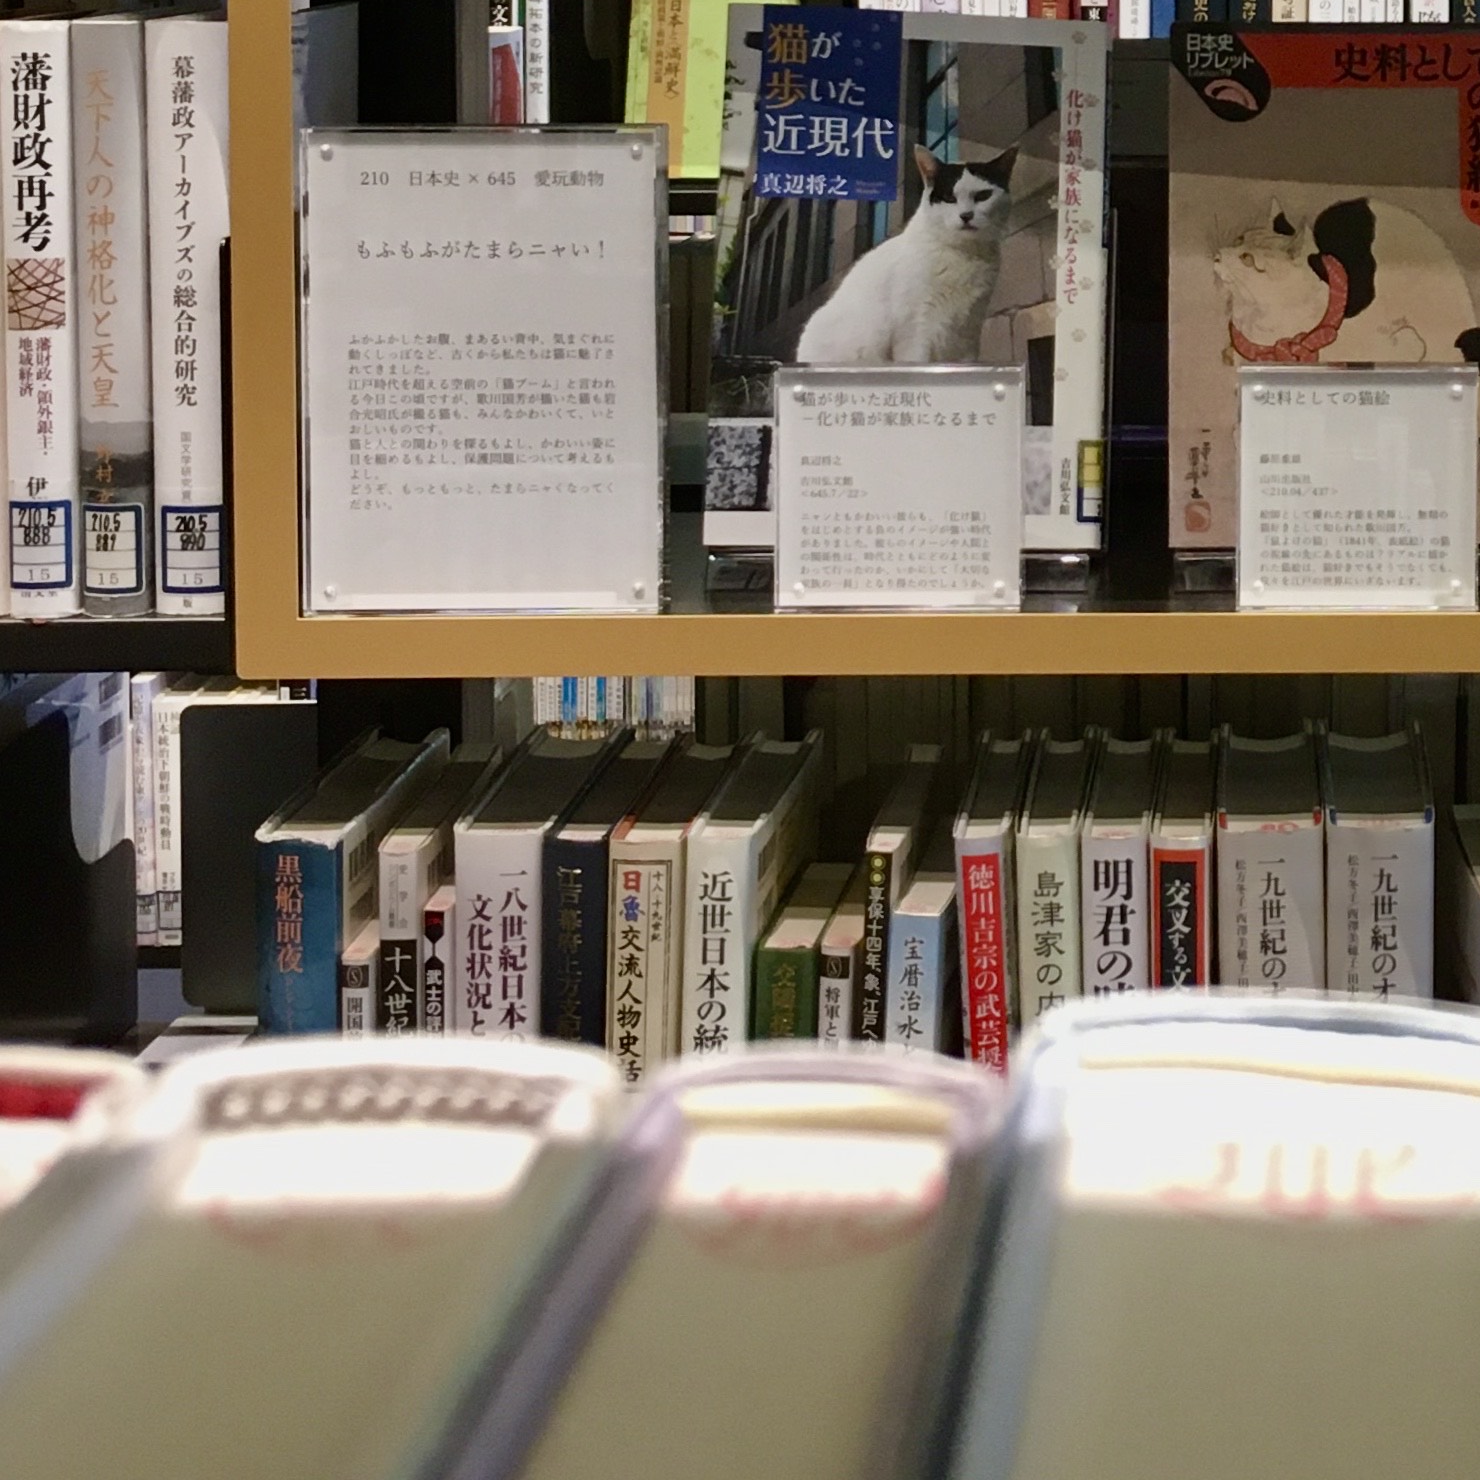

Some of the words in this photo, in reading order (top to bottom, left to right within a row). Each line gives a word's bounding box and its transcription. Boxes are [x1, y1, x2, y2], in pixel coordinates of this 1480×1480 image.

[768, 22, 843, 65] 猫が
[1186, 33, 1235, 52] 日本史
[1186, 53, 1255, 71] リブレット
[764, 68, 867, 110] 歩いた
[10, 52, 53, 253] 藩財政再考
[761, 113, 896, 161] 近現代
[360, 171, 390, 187] 210
[408, 170, 461, 188] 日本史
[487, 171, 516, 187] 645
[533, 169, 605, 188] 愛玩動物
[759, 173, 849, 197] 真辺将之
[1061, 88, 1085, 306] 化け猫が家族になるまで
[85, 69, 121, 409] 天下人の神格化と天皇
[170, 56, 199, 408] 幕藩政アーカイブズの総合的研究
[356, 239, 607, 260] もふもふがたまらニャい！
[18, 337, 34, 398] 地域経済
[1262, 390, 1391, 406] 史料としての猫絵
[23, 526, 51, 545] 888
[27, 568, 51, 582] 15
[274, 853, 304, 974] 黒船前夜
[465, 893, 494, 1038] 文化状況と
